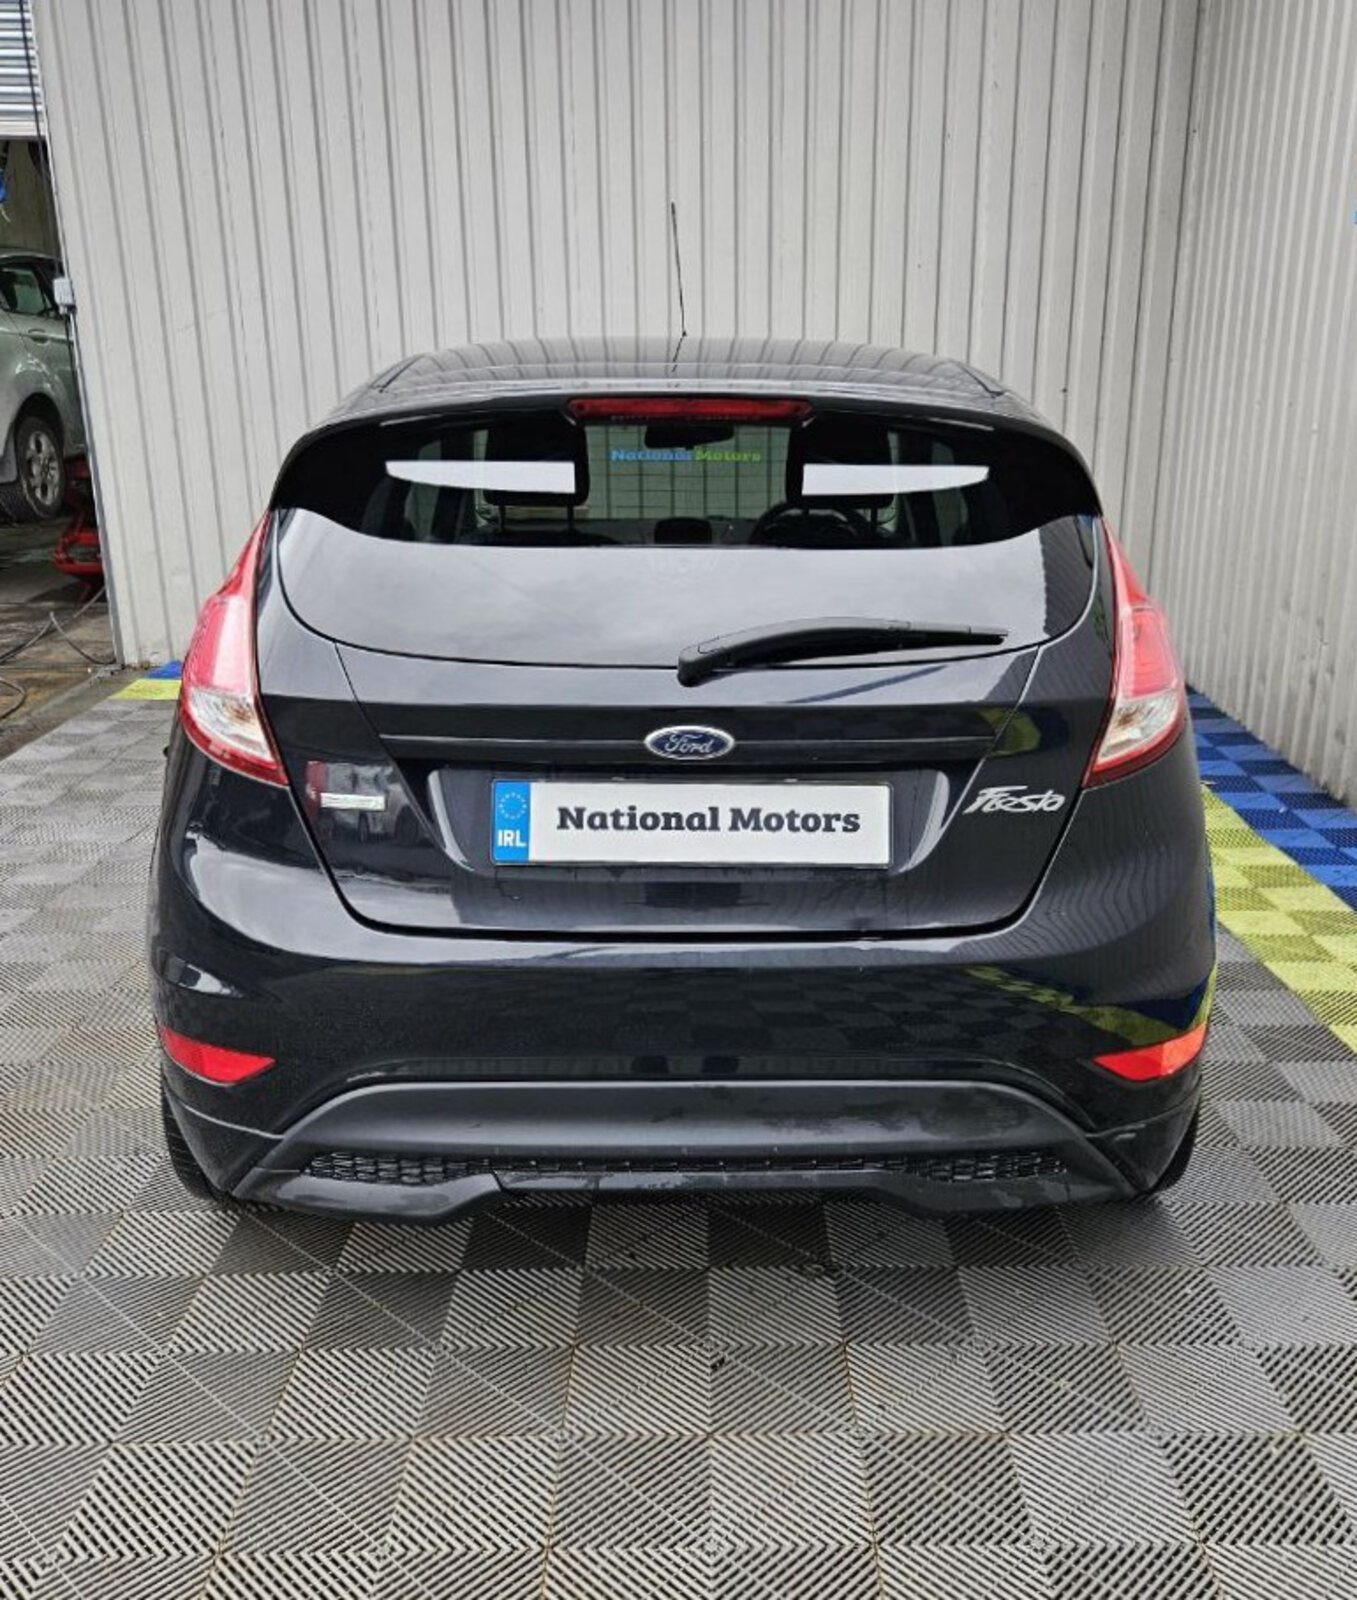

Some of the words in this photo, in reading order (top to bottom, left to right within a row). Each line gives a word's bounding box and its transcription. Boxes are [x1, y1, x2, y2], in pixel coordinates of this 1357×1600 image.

[695, 449, 761, 461] Motors
[664, 733, 714, 753] Ford
[962, 785, 1066, 814] Fiesta
[556, 806, 720, 832] National
[728, 807, 861, 833] Motors
[497, 830, 527, 847] IRL
